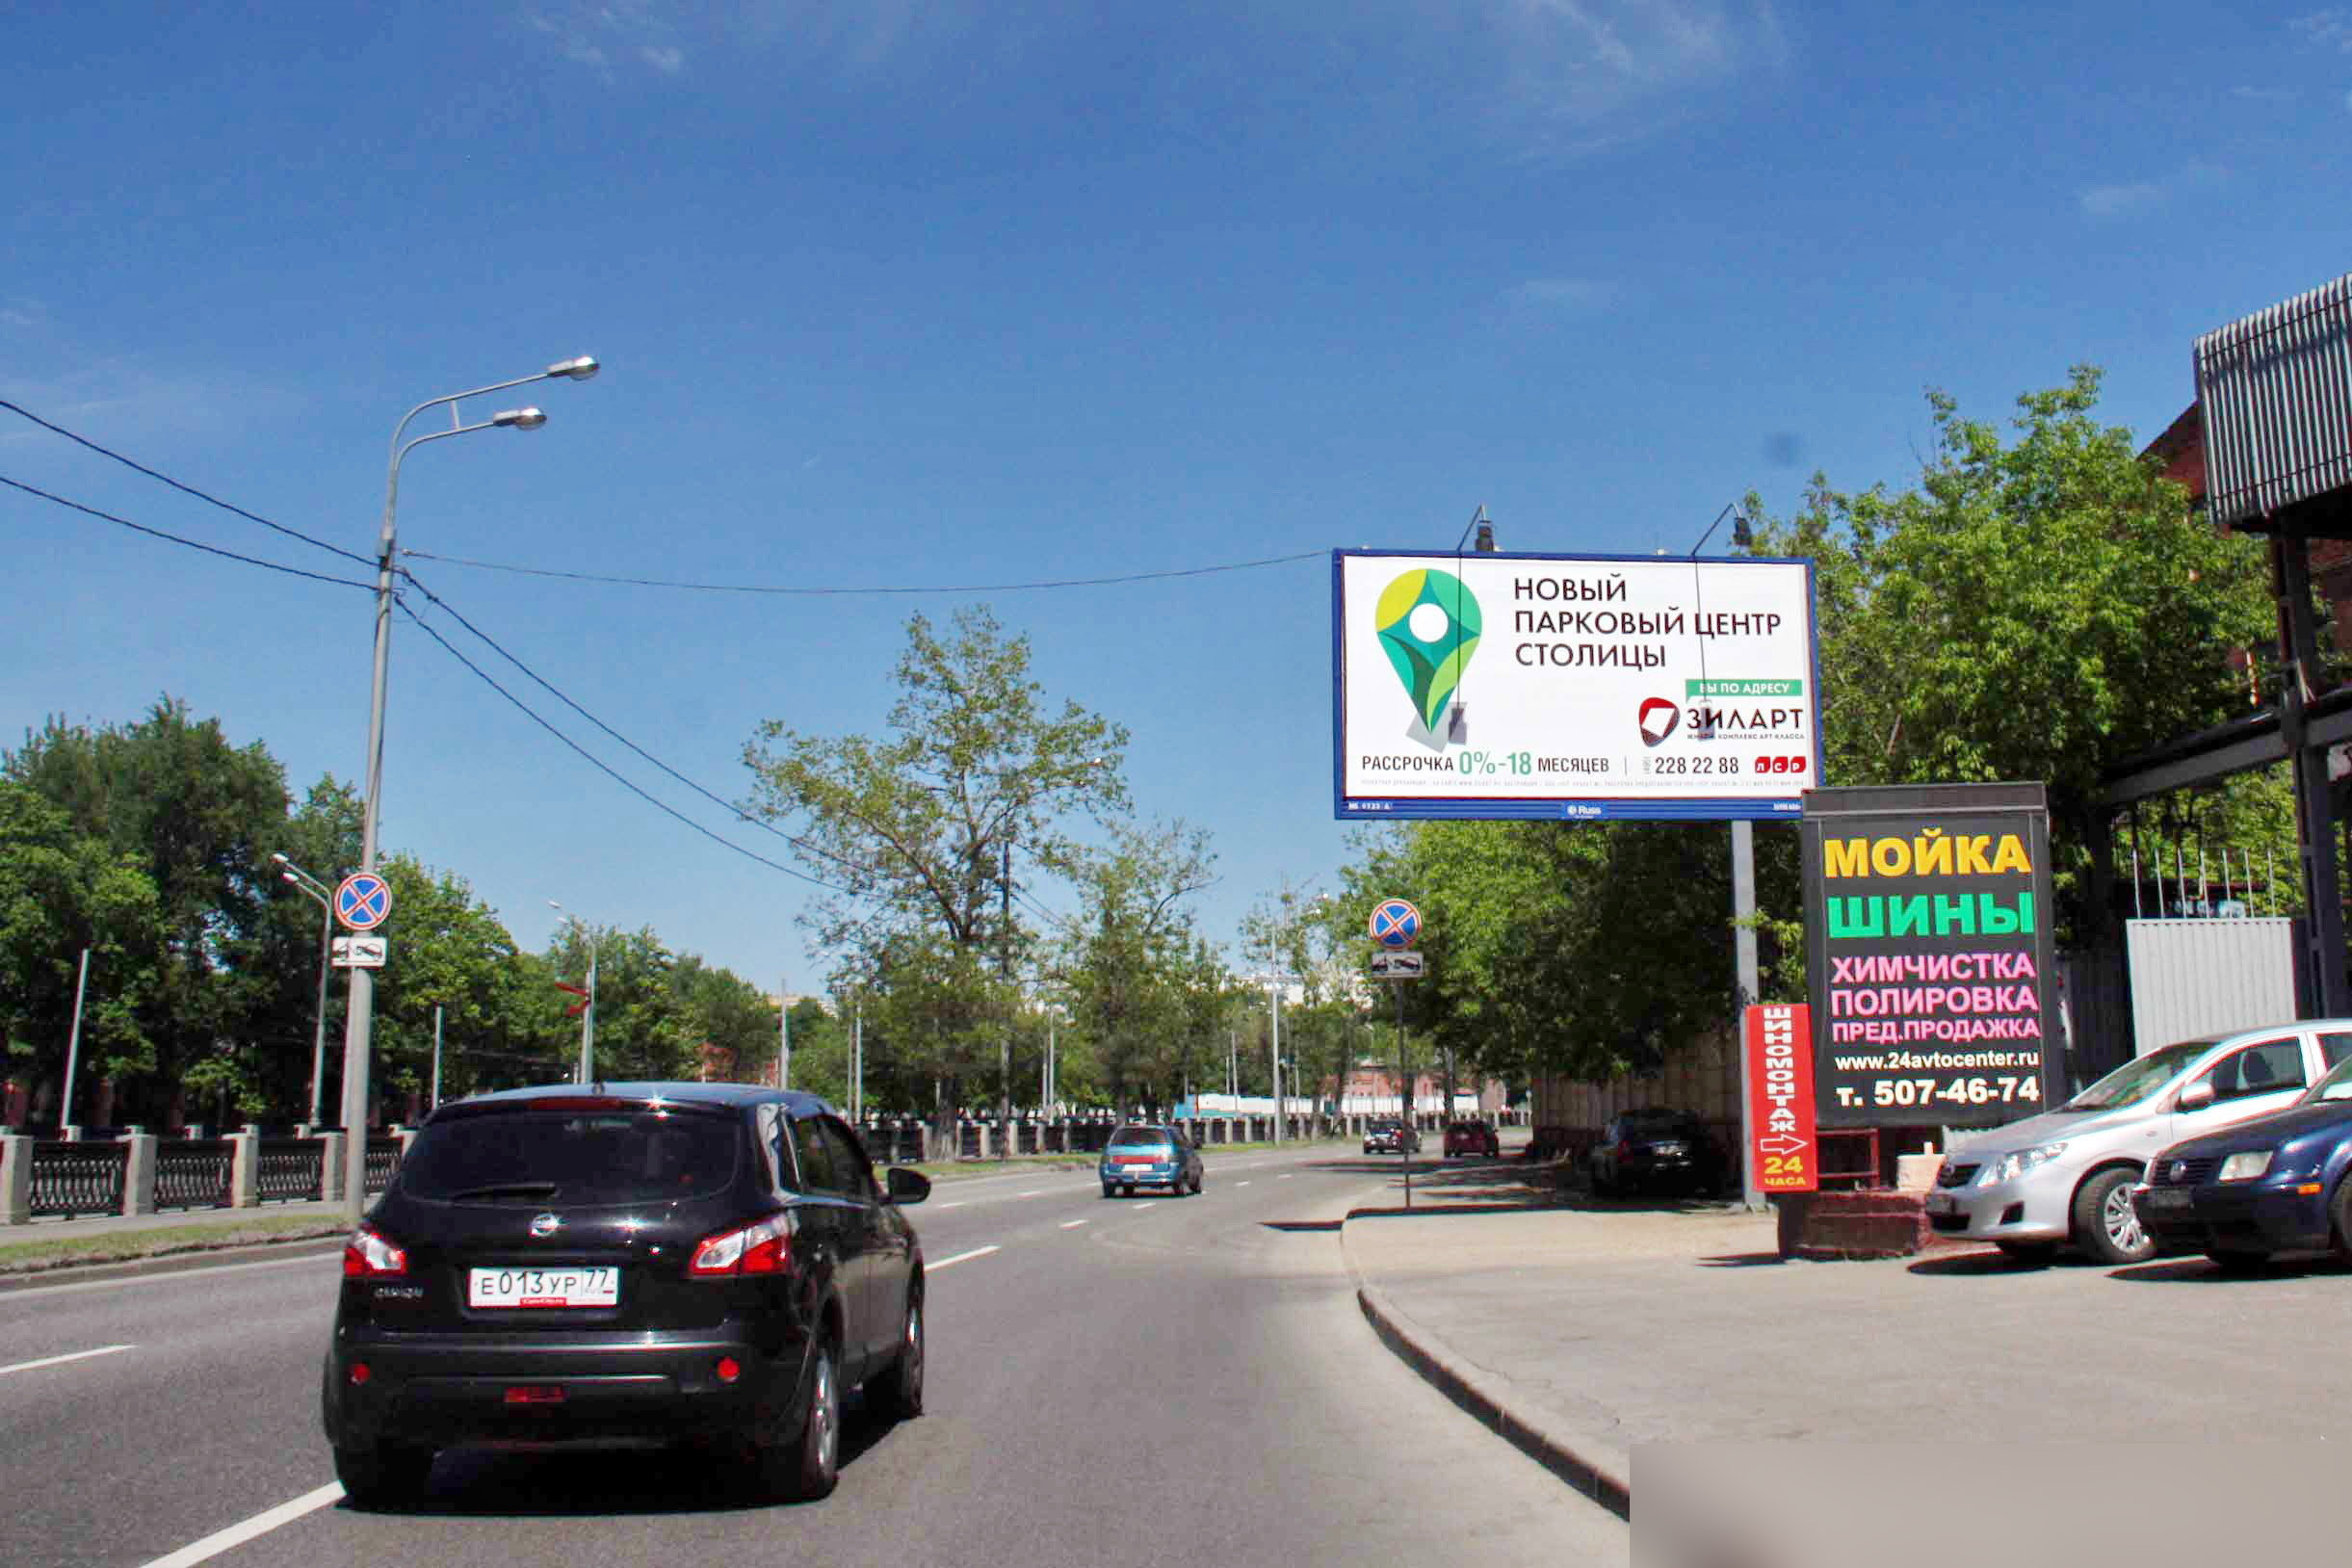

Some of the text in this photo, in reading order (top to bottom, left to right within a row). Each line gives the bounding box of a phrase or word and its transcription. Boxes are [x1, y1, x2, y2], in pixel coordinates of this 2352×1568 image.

[1514, 573, 1627, 601] НОВЫЙ
[1515, 606, 1781, 640] ПАРКОВЫЙ ЦЕНТР
[1515, 642, 1666, 671] СТОЛИЦЫ
[1720, 683, 1739, 693] ПО
[1742, 683, 1790, 694] АДРЕСУ
[1687, 708, 1804, 729] ЗИЛАРТ
[1362, 751, 1609, 774] РАССРОЧКА 0%-18 МЕСЯЦЕВ
[1655, 756, 1686, 773] 228
[1692, 756, 1713, 773] 22
[1719, 756, 1739, 773] 88
[1823, 825, 2032, 877] МОЙКА
[1827, 892, 2035, 938] ШИНЫ
[1831, 953, 2036, 983] ХИМЧИСТКА
[1831, 985, 2040, 1017] ПОЛИРОВКА
[1832, 1017, 2042, 1044] ПРЕД.ПРОДАЖКА
[1763, 1006, 1796, 1133] ШИНОМОНТАЖ
[1834, 1051, 2040, 1071] www.24avtocenter.ru
[1873, 1075, 2040, 1107] 507-46-74
[1764, 1156, 1804, 1175] 24
[1764, 1176, 1807, 1186] ЧАСА
[586, 1268, 609, 1288] 77
